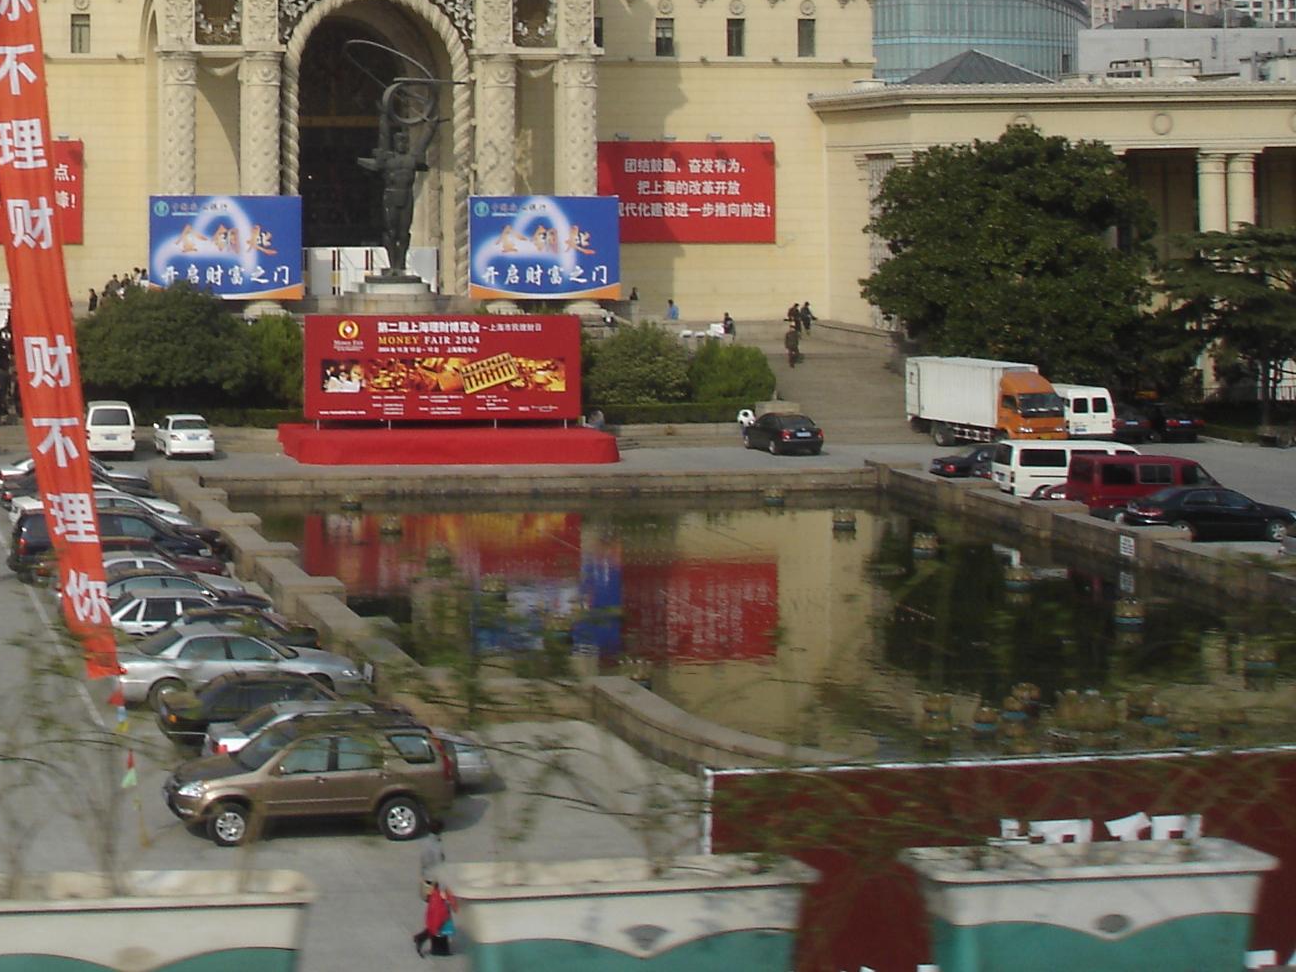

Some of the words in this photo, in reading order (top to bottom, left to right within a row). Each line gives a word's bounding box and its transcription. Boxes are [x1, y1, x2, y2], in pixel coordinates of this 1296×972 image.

[637, 180, 741, 195] 把上海的改革开放
[161, 264, 290, 286] 开启财富之门
[481, 264, 609, 286] 开启财富之门
[378, 336, 419, 345] MONEY
[424, 336, 451, 345] FAIR
[455, 336, 481, 345] 2004
